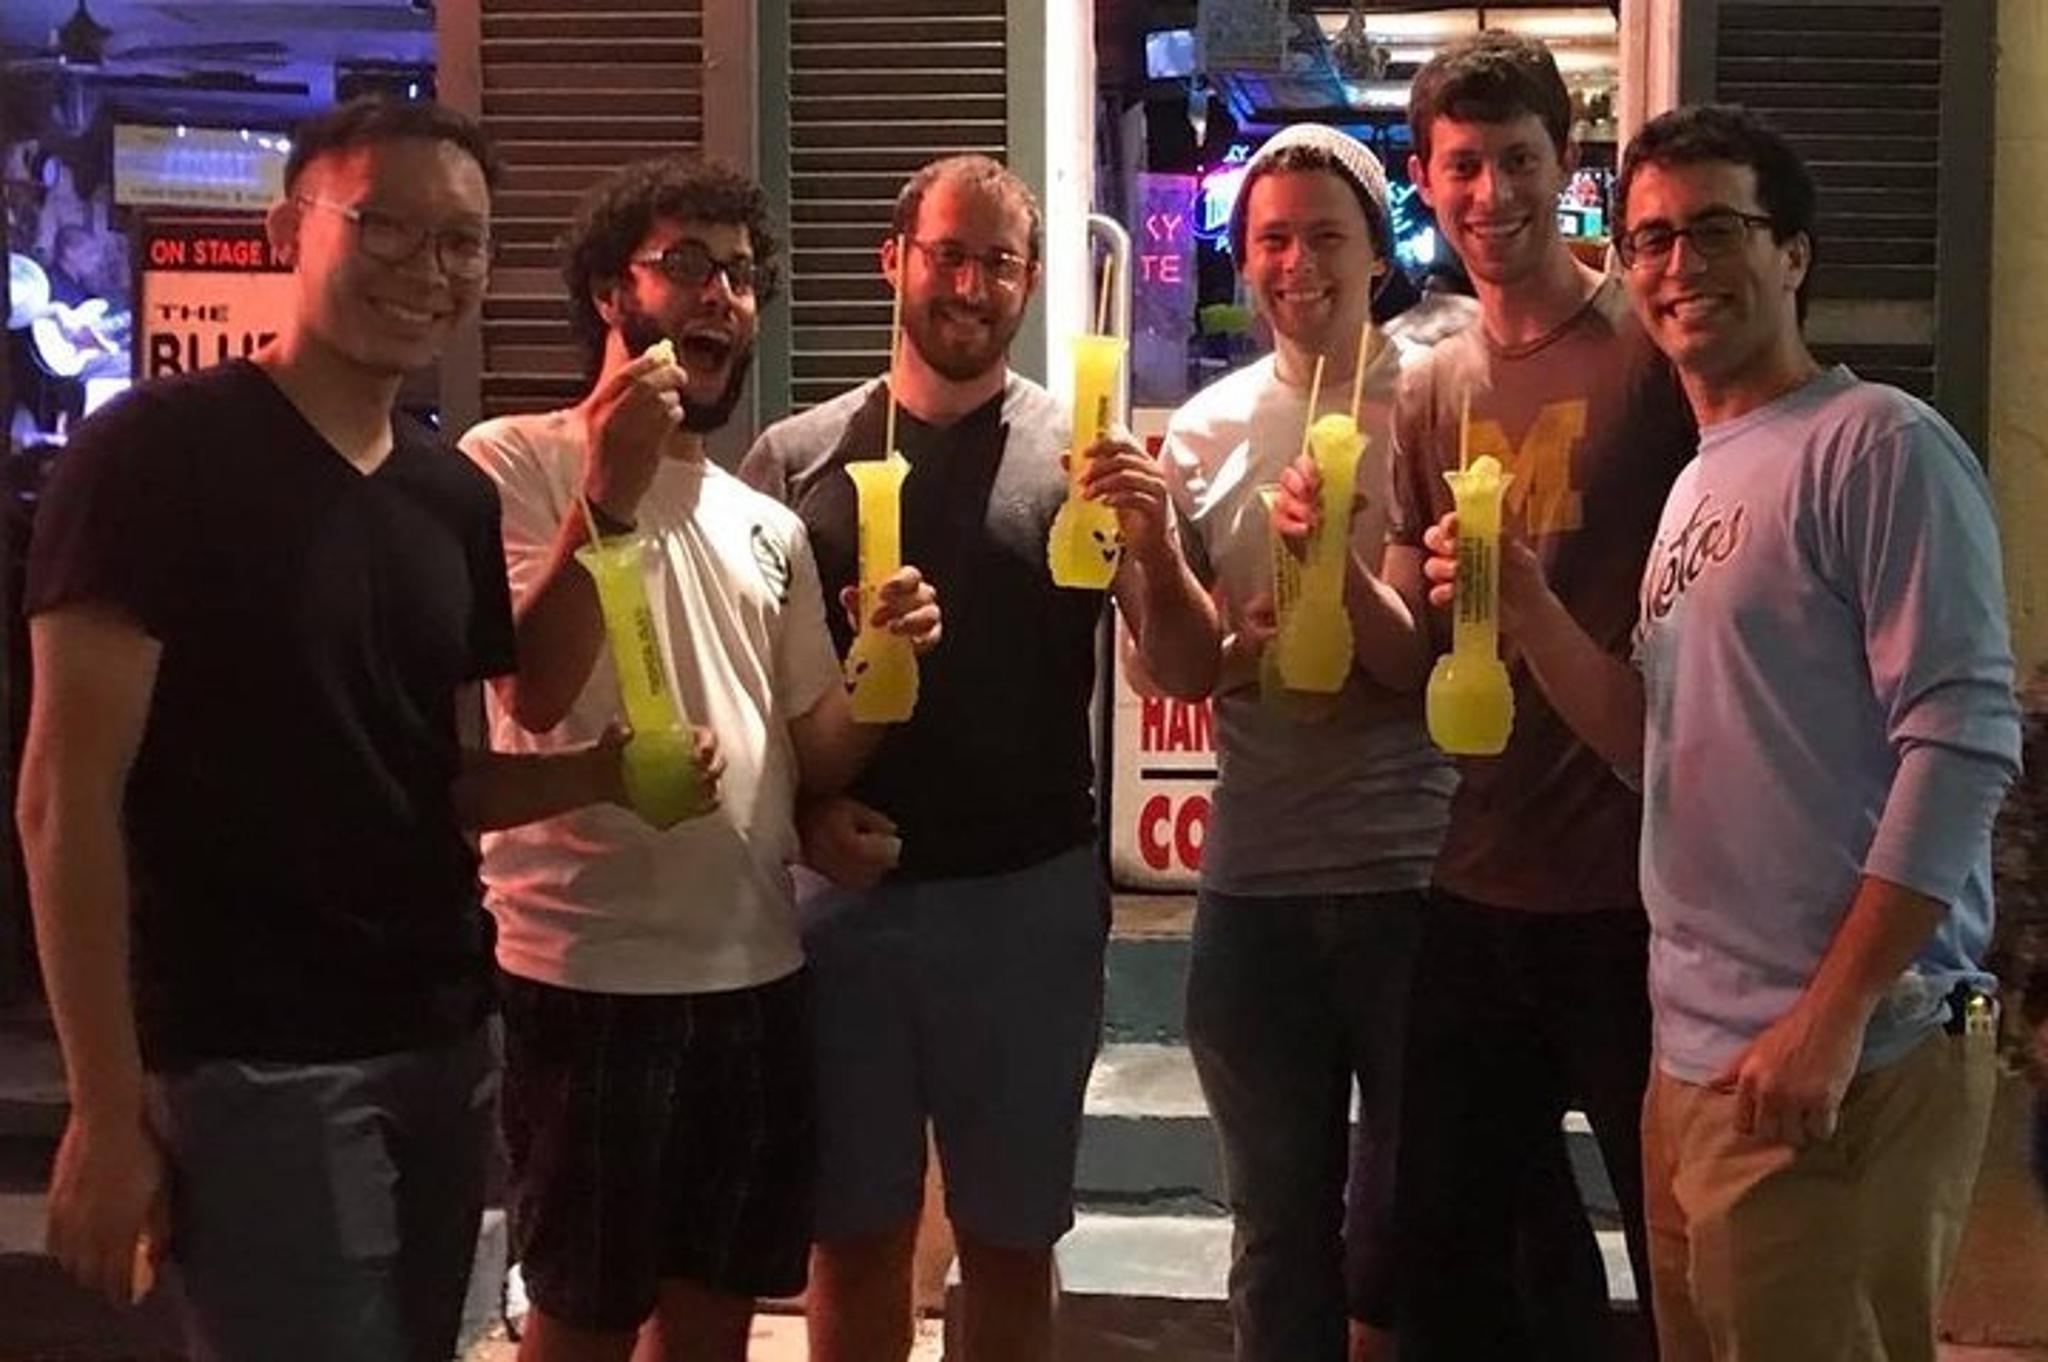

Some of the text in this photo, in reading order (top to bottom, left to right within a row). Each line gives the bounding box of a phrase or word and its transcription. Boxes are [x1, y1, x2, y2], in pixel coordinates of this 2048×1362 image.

[151, 238, 185, 265] ON
[193, 238, 263, 266] STAGE
[154, 303, 229, 322] THE
[1462, 398, 1587, 537] M
